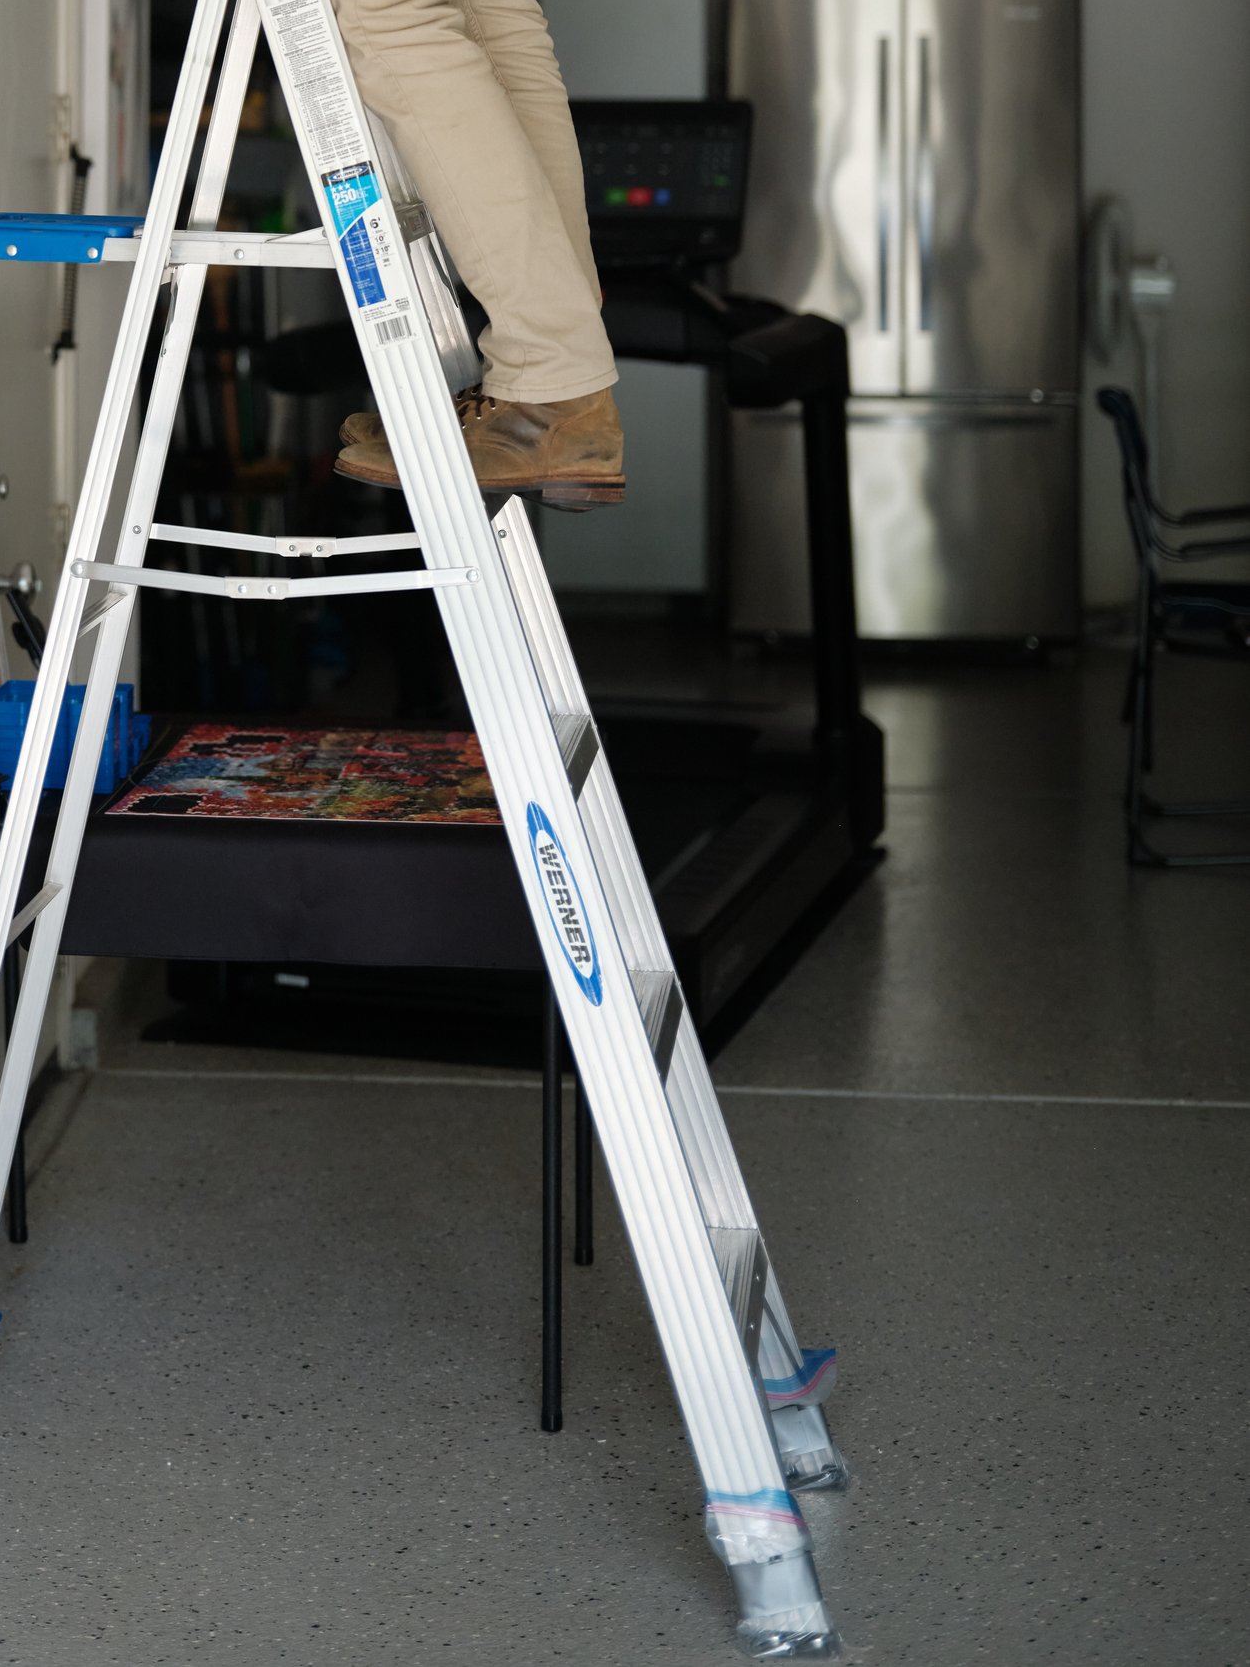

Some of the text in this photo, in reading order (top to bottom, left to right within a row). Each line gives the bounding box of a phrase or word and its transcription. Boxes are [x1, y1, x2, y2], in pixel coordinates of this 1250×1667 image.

[334, 188, 357, 205] 250
[369, 216, 381, 229] 6'
[537, 842, 592, 968] WERNER
